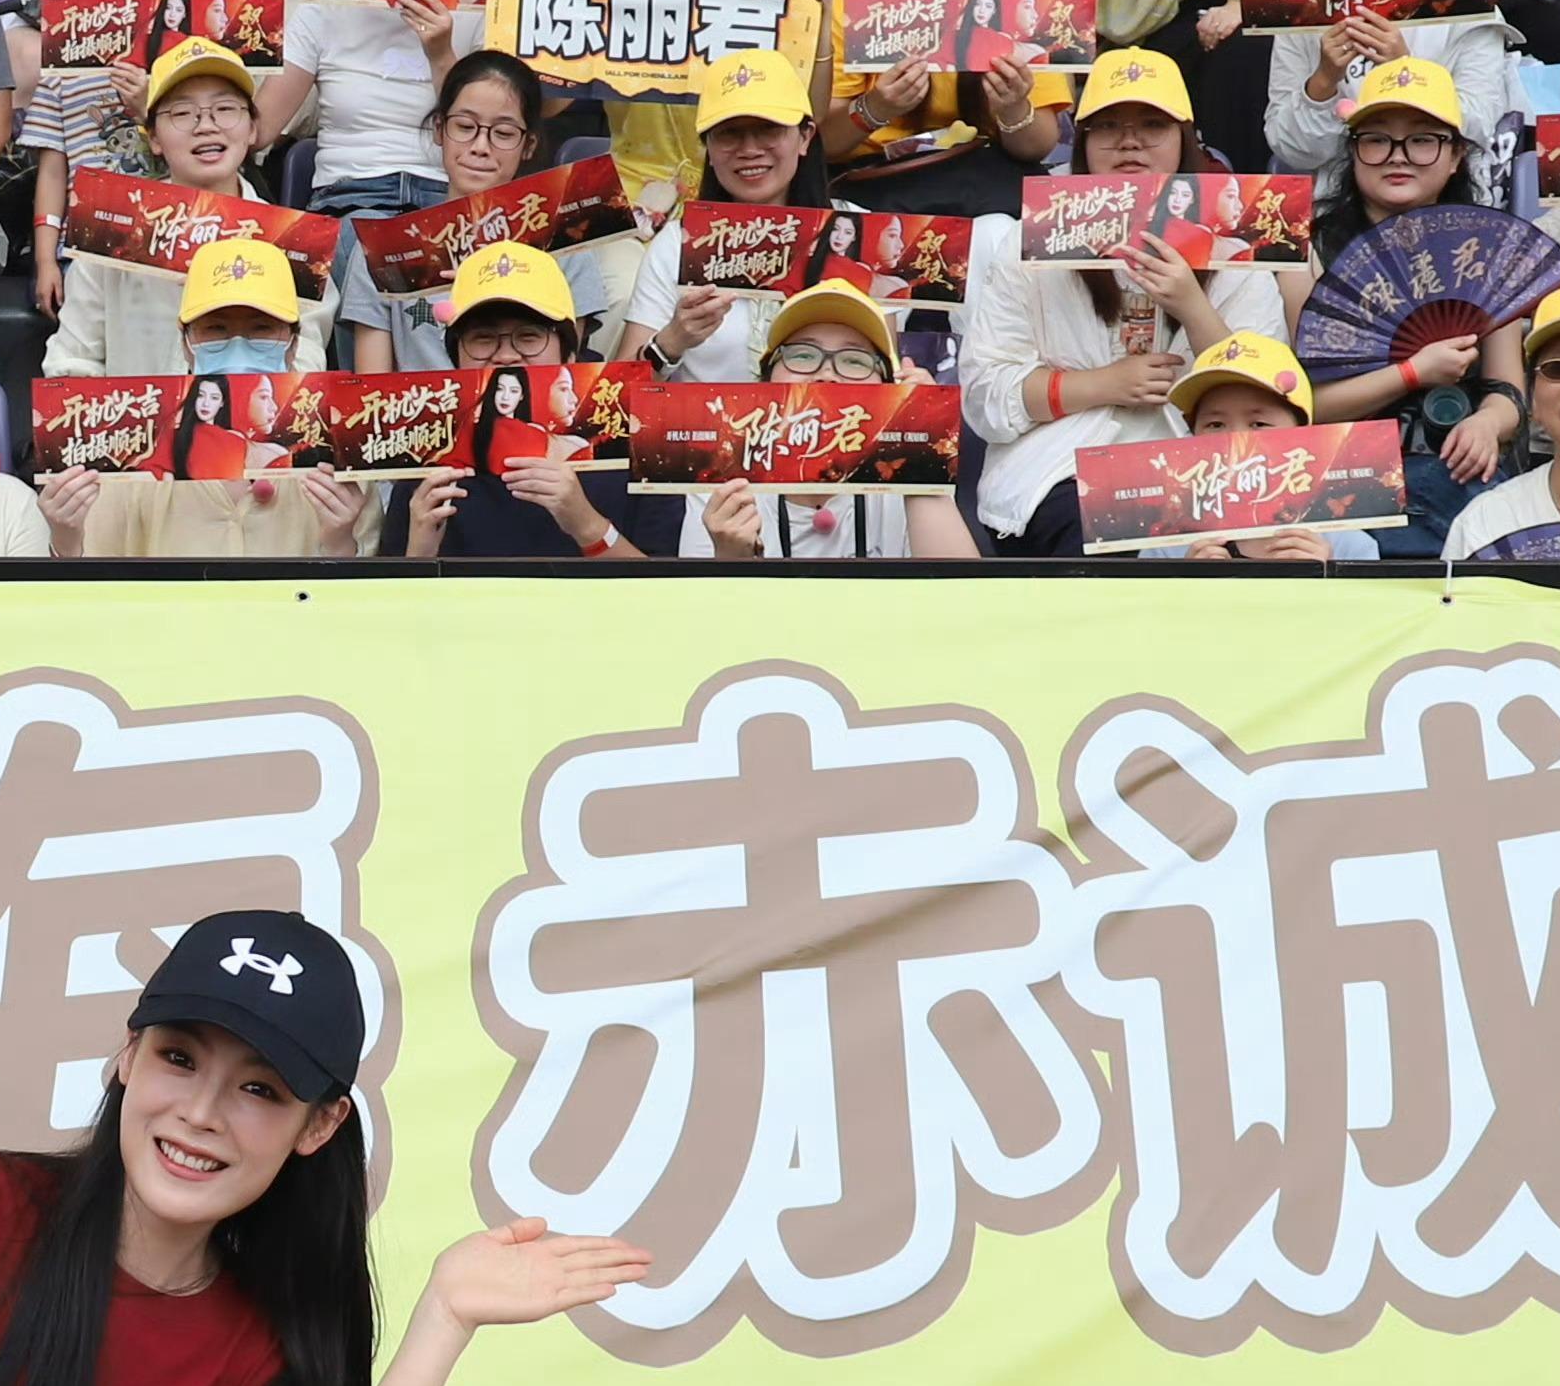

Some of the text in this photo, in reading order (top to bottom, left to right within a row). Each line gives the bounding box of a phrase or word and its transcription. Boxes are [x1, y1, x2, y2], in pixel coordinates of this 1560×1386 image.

[49, 0, 138, 35] 开机大吉
[693, 213, 800, 251] 开机大吉
[1034, 183, 1137, 230] 开机大吉
[47, 387, 162, 443] 开机大吉
[346, 376, 461, 435] 开机大吉
[732, 402, 871, 470] 陈丽君
[1176, 448, 1317, 519] 陈丽君
